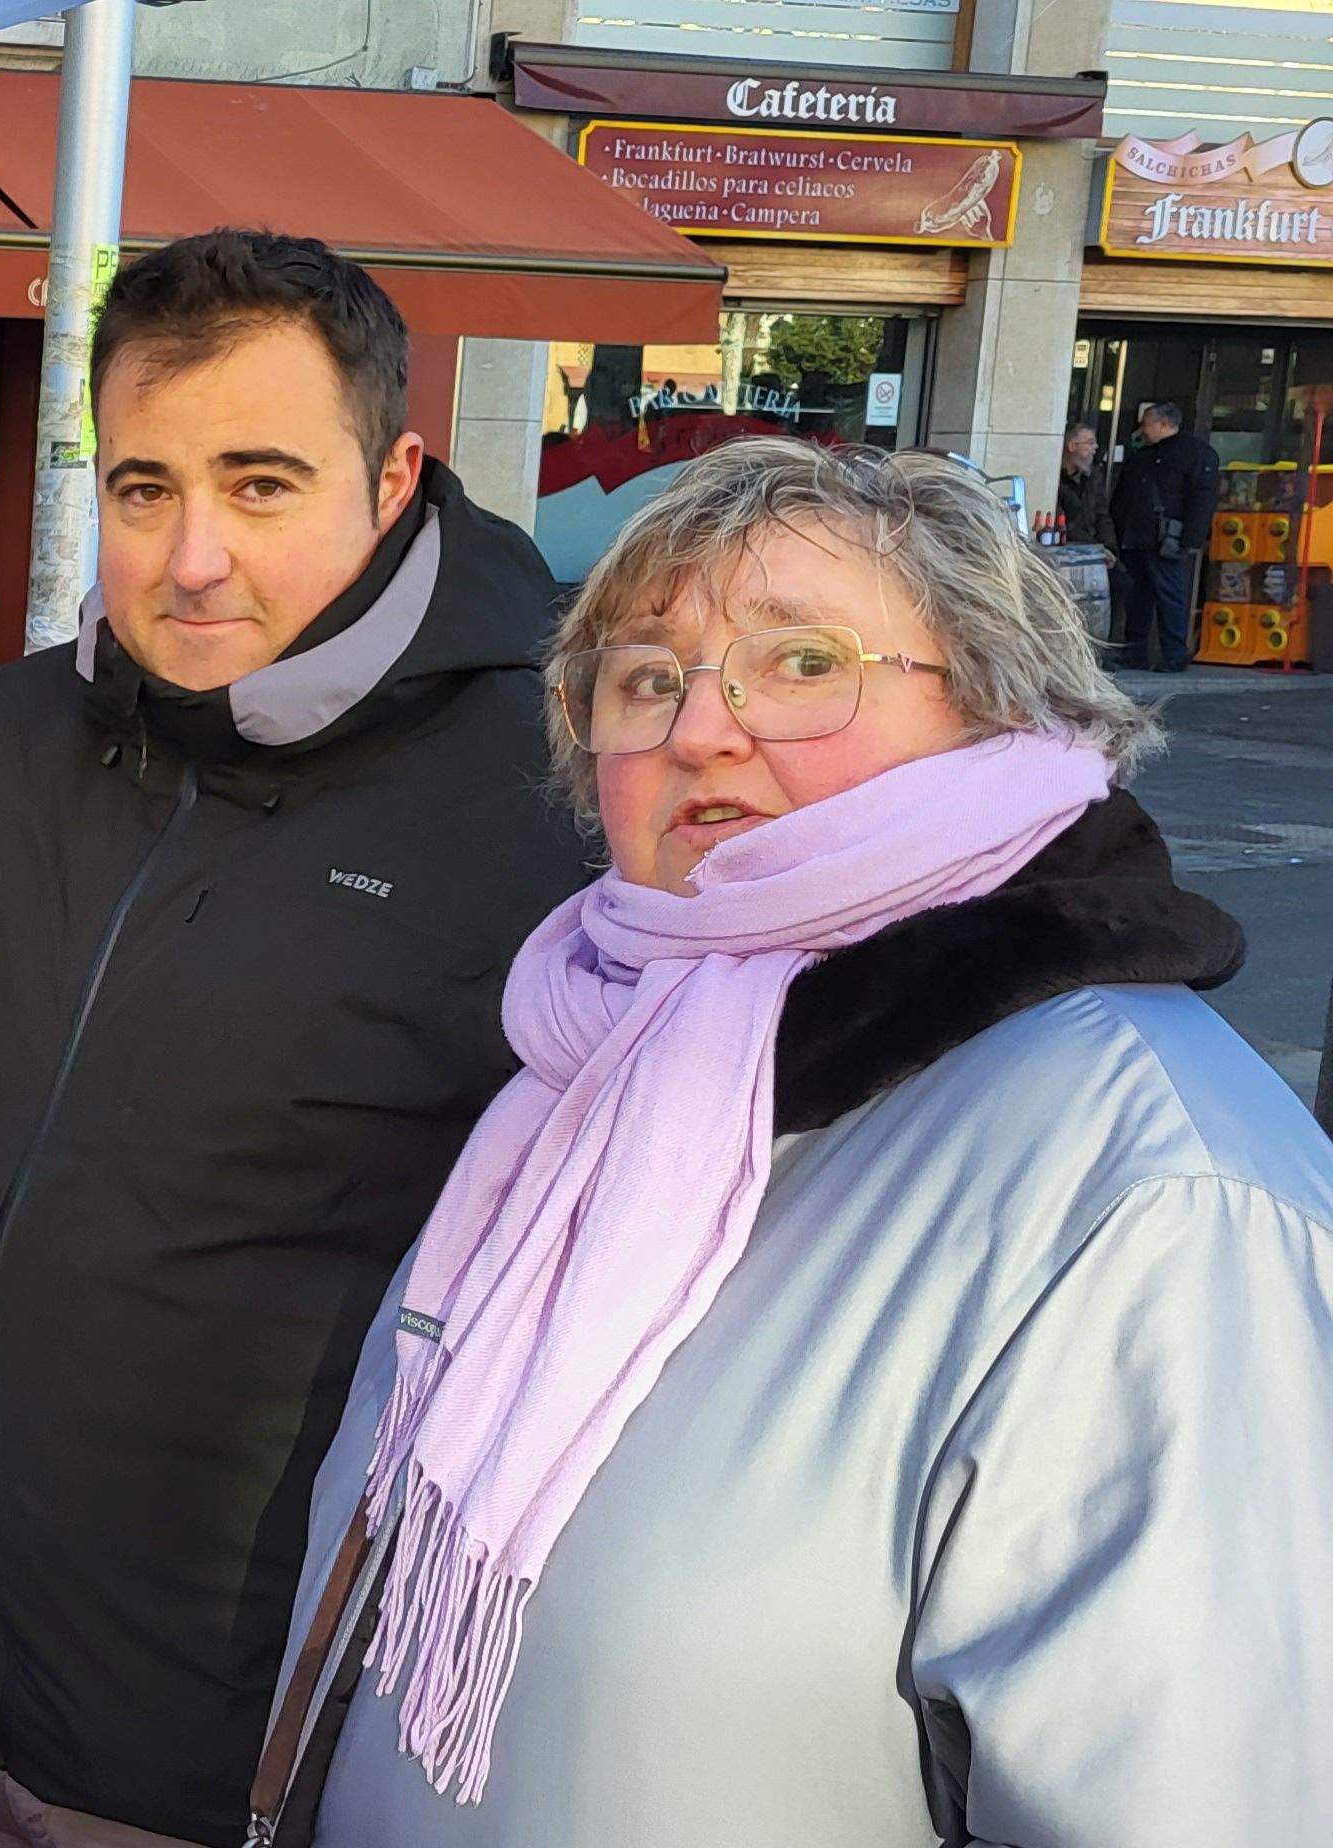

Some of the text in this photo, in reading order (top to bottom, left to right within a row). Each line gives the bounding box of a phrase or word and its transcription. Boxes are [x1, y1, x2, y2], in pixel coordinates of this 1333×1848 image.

[726, 77, 898, 124] Cafetería
[613, 138, 913, 174] Frankfurt Bratwurst Cervela
[1127, 147, 1237, 179] SALCHICHAS
[611, 167, 717, 192] Bocadillos
[722, 177, 769, 198] para
[641, 197, 821, 228] lagueña Campera
[1136, 192, 1322, 245] Frankfurt
[328, 868, 394, 898] WEDZE
